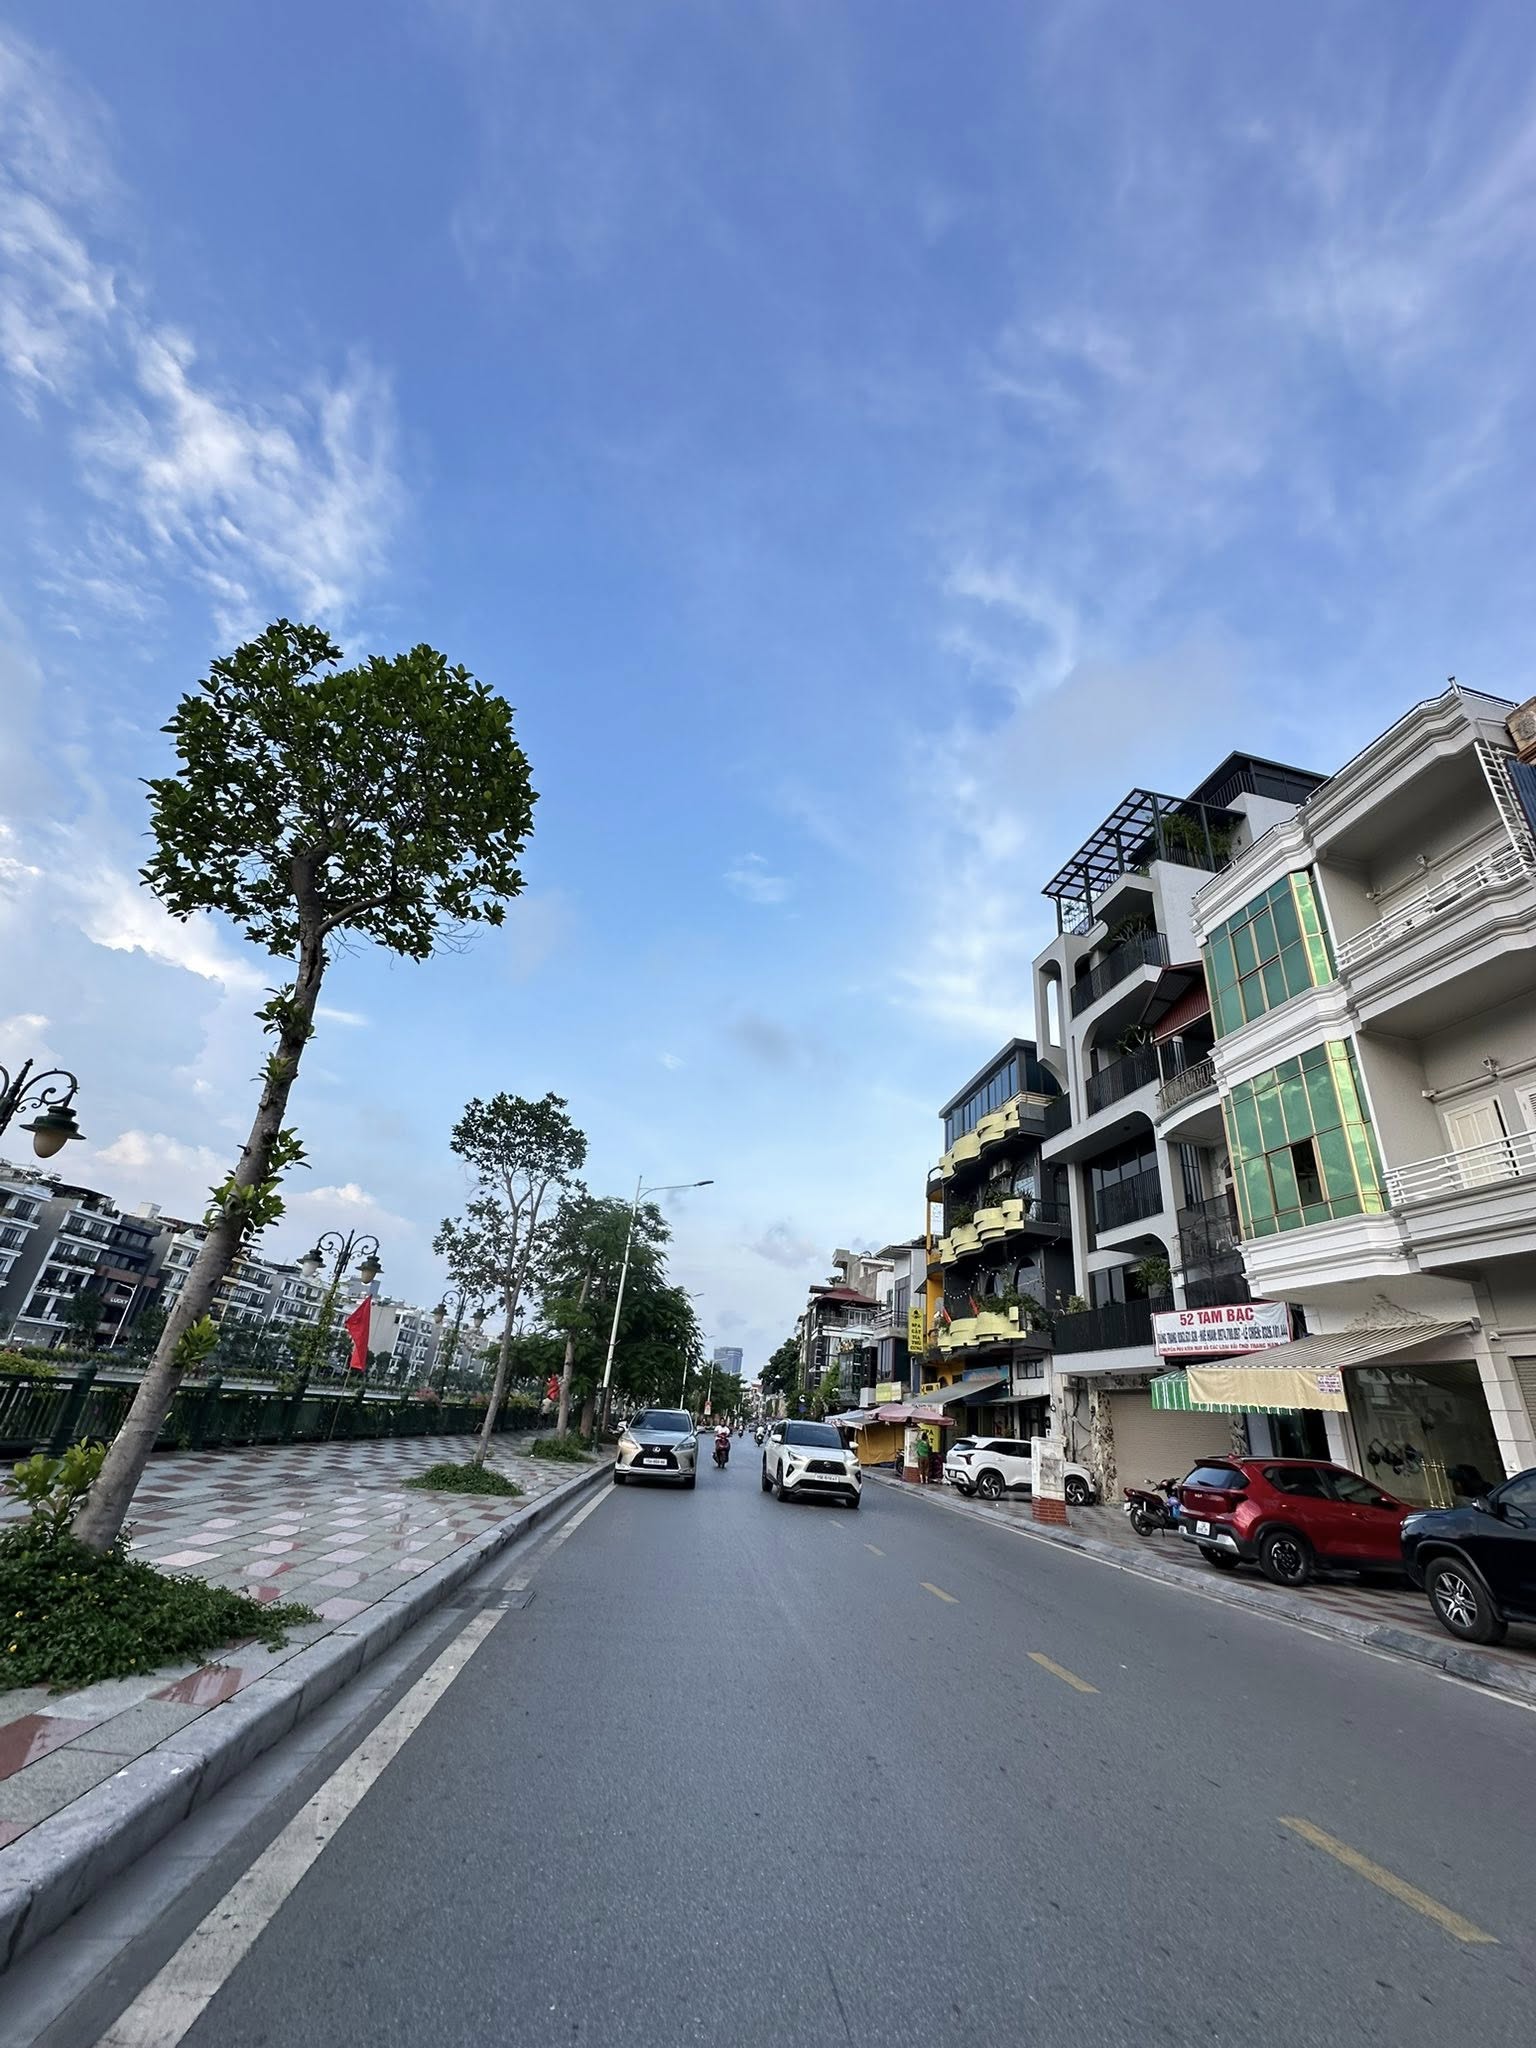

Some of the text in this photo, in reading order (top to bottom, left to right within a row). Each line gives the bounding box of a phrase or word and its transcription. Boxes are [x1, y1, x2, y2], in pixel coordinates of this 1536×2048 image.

[1180, 1307, 1254, 1326] 52 TAM BẠC
